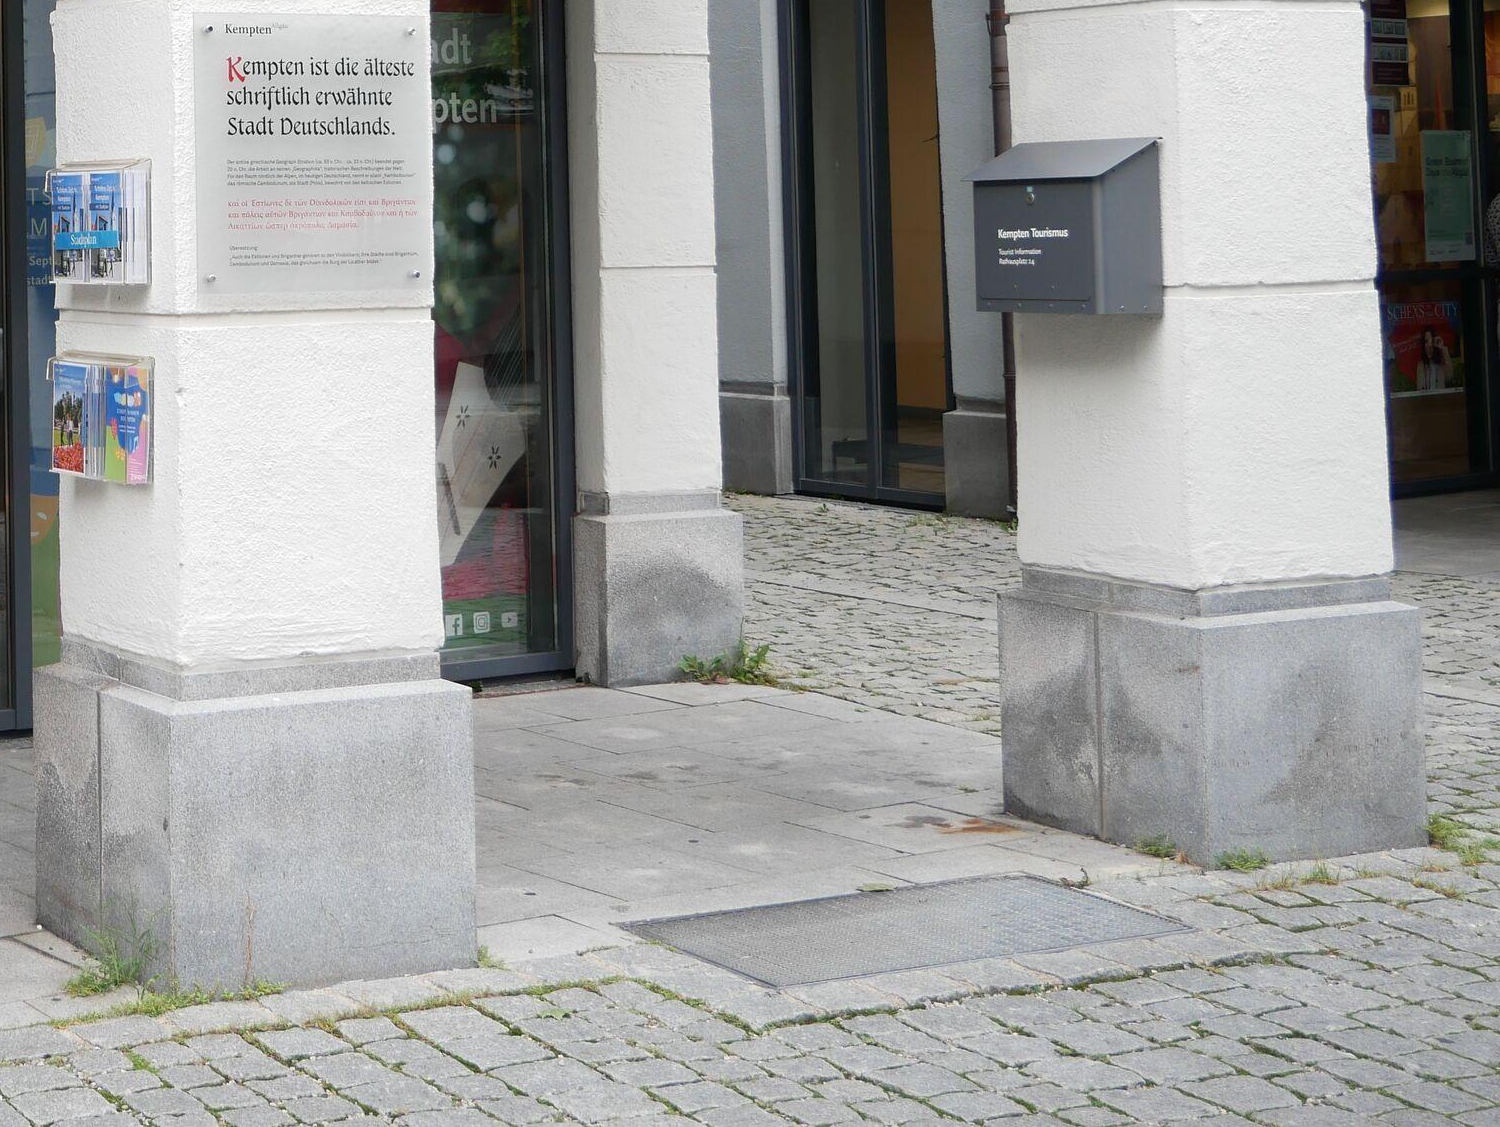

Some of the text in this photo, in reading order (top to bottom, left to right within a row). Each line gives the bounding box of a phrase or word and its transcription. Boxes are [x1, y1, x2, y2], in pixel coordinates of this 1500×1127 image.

[225, 23, 272, 37] Kempten
[431, 27, 472, 65] adt
[226, 56, 415, 83] Kempten ist die älteste
[226, 85, 393, 111] schriftlich erwähnte
[227, 116, 396, 136] Stadt Deutschlands.
[432, 92, 497, 134] pten
[997, 226, 1069, 241] Kempten Tourismus
